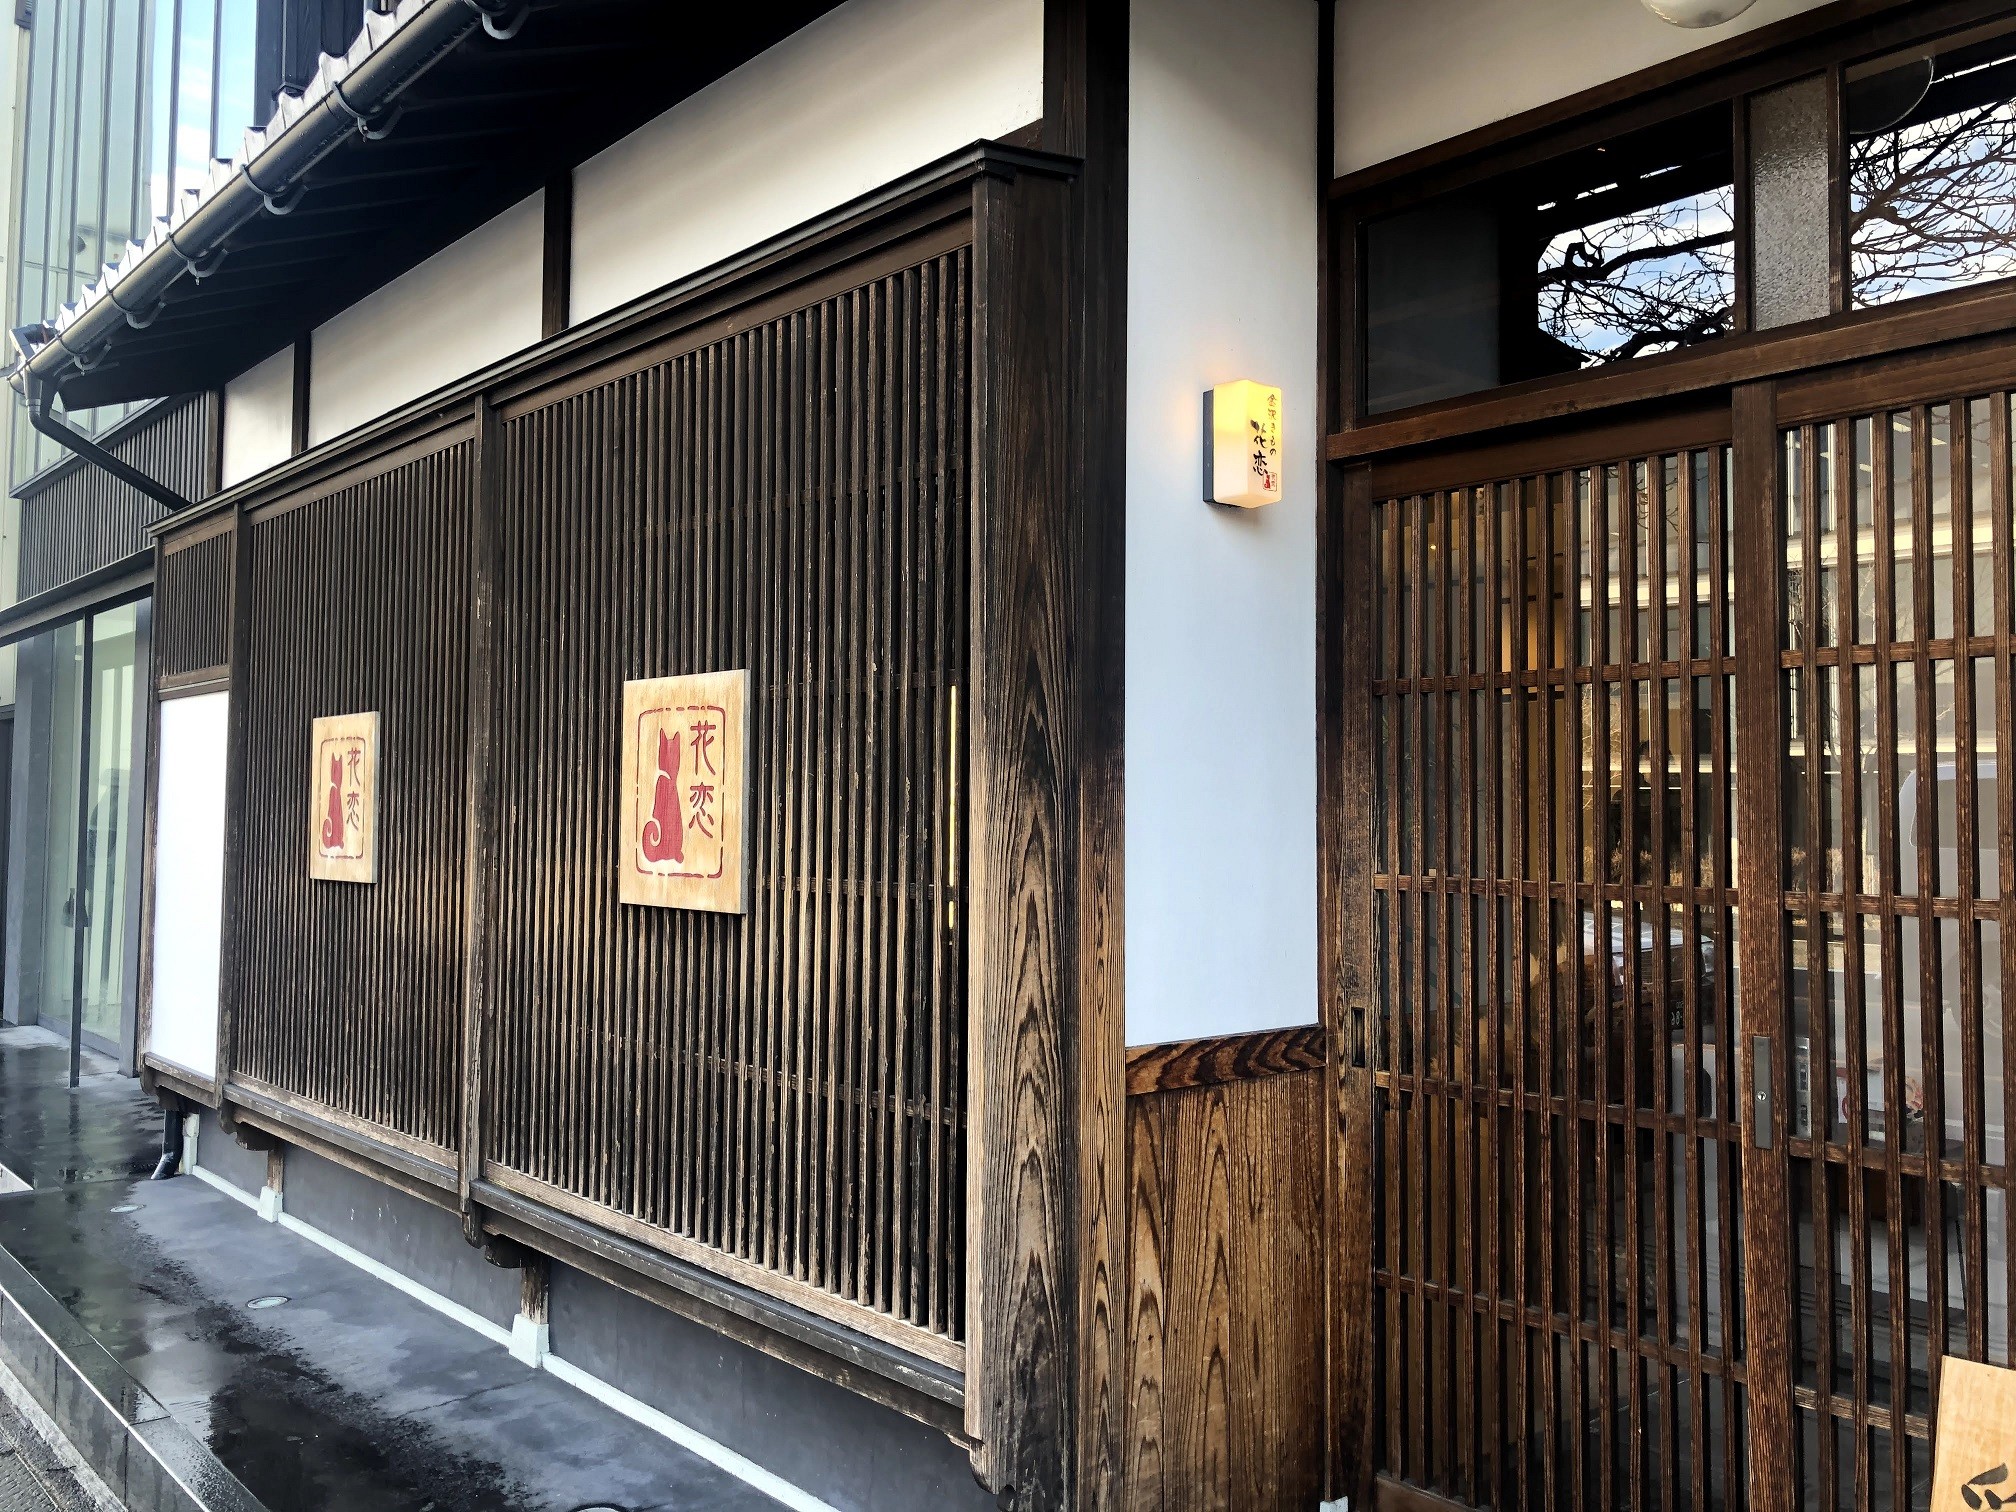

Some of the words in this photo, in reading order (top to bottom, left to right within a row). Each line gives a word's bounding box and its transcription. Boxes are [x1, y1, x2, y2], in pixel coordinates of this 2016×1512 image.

[1251, 419, 1268, 476] 花恋
[346, 747, 361, 831] 花恋
[689, 720, 716, 839] 花恋
